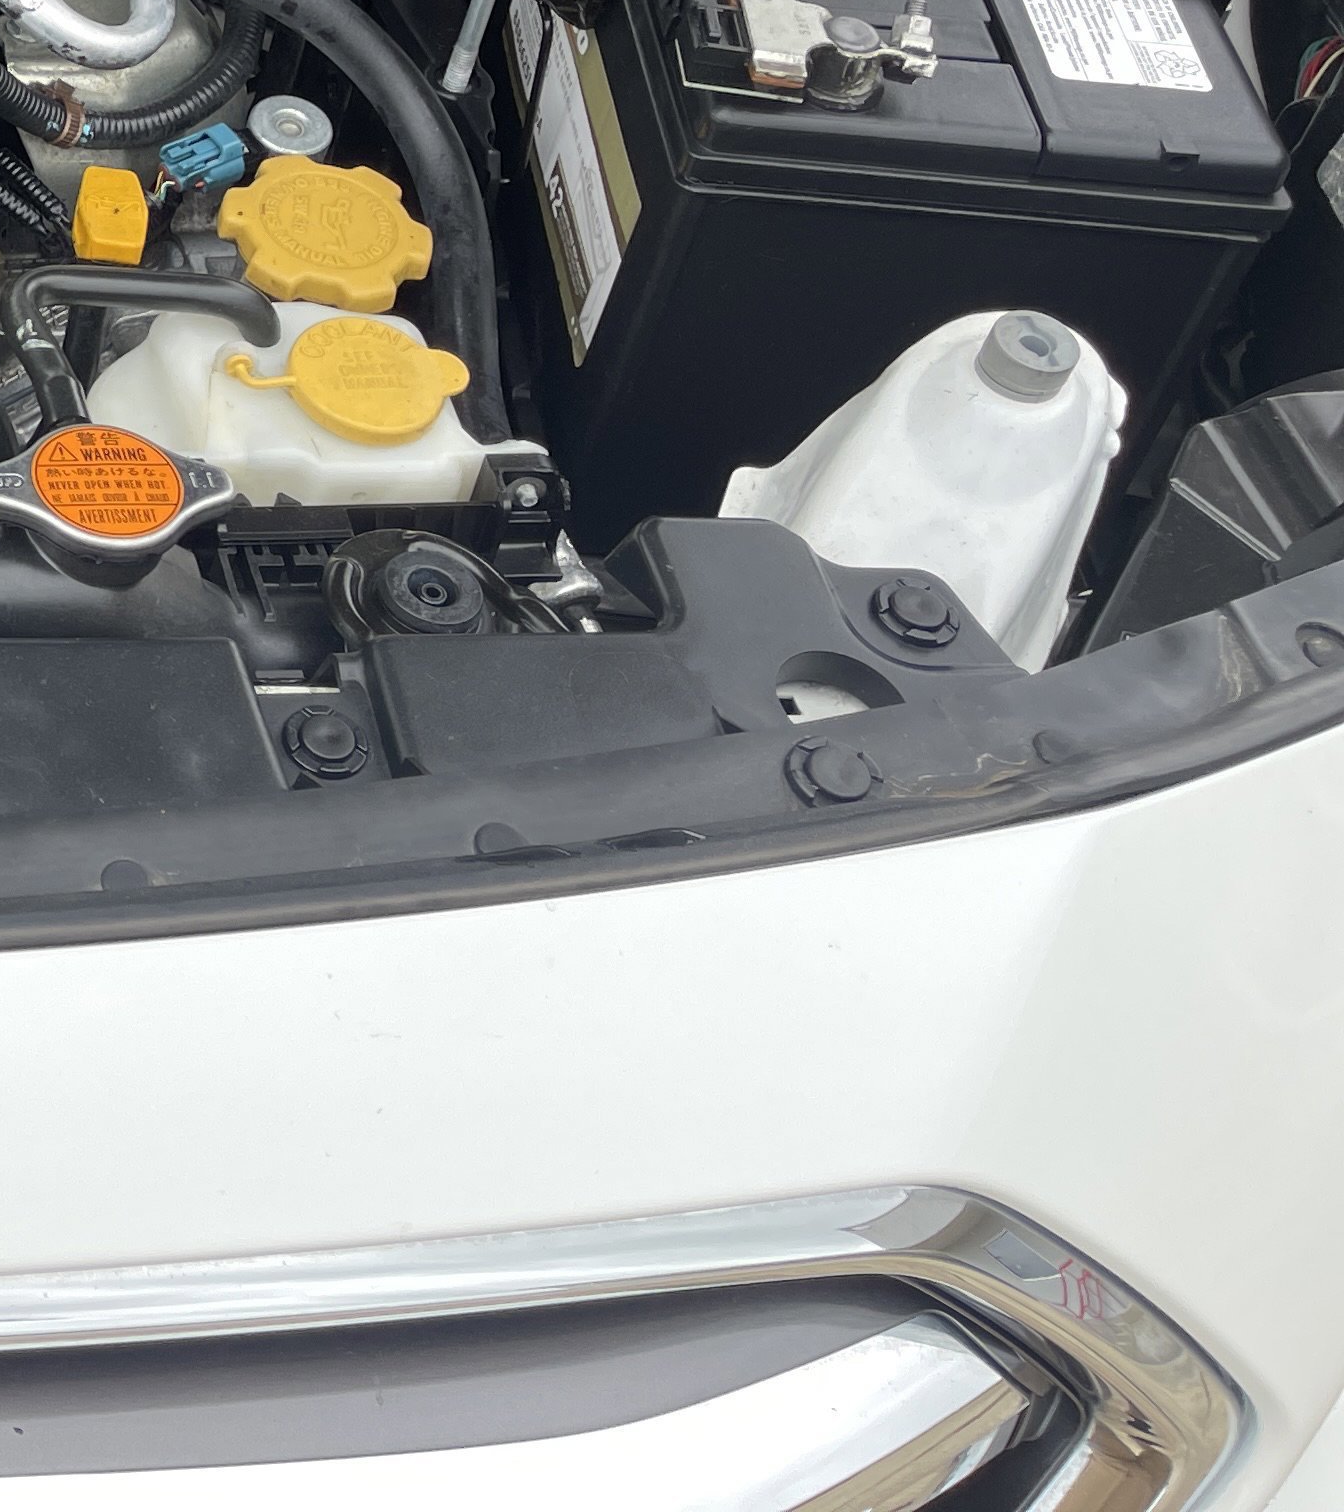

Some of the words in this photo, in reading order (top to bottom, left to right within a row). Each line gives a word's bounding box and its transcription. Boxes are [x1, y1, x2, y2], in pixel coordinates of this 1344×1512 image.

[79, 447, 148, 463] WARNING
[47, 479, 80, 490] NEVER
[84, 480, 111, 490] OPEN
[114, 479, 143, 490] WHEN
